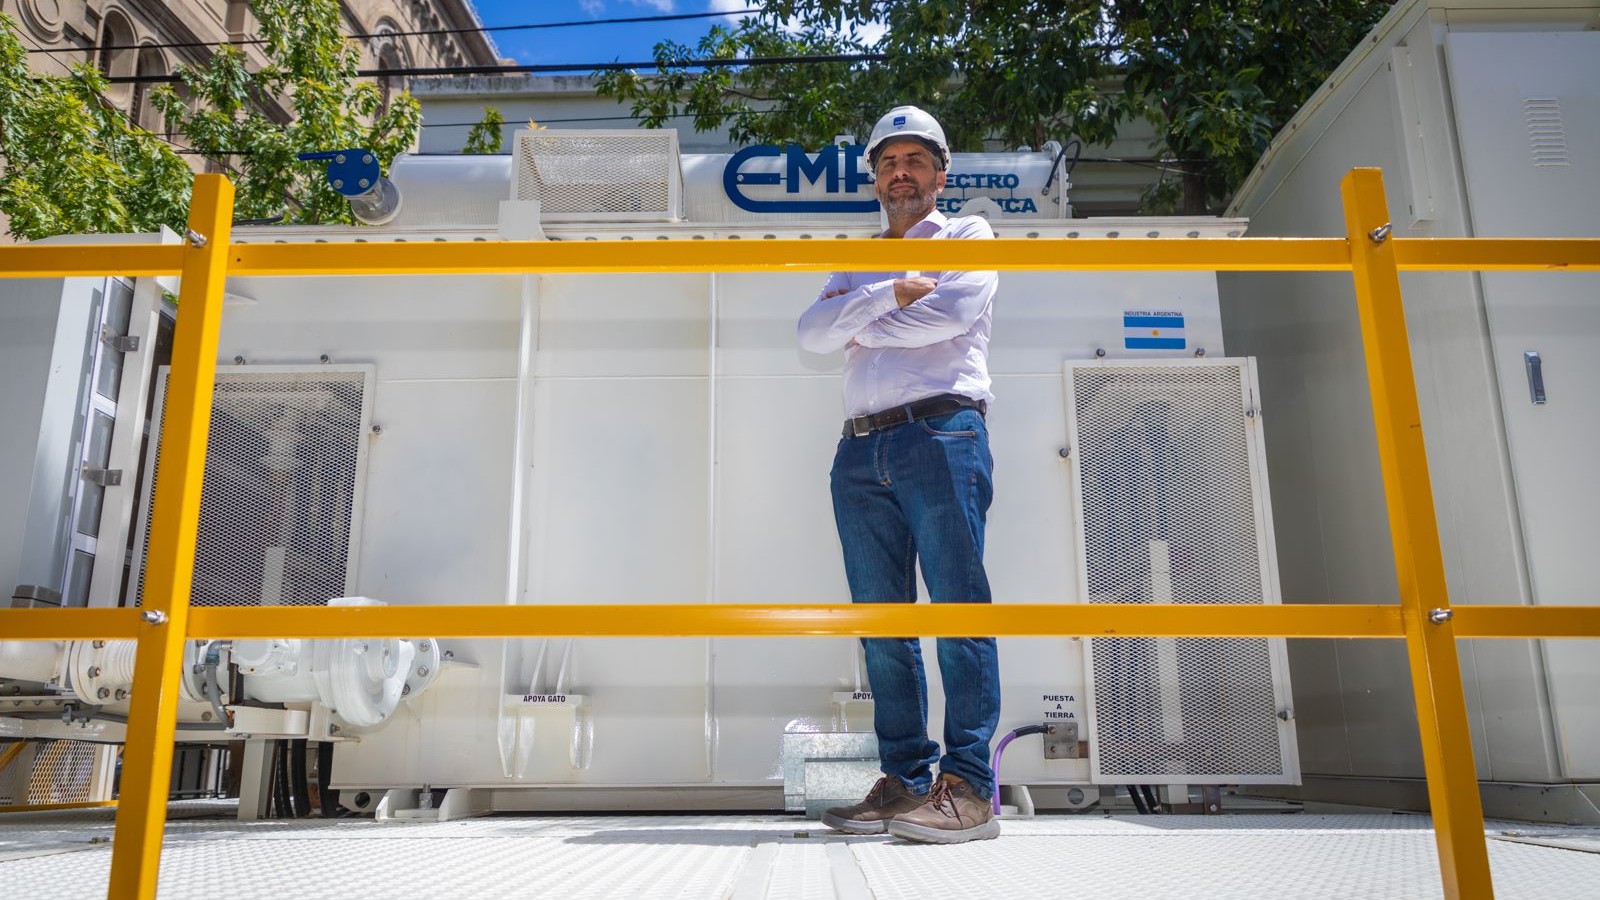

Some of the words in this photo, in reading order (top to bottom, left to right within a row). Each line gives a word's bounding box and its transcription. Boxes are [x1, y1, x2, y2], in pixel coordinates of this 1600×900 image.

[944, 173, 1019, 188] ECTRO
[547, 695, 566, 703] GATO
[852, 692, 873, 700] APOY
[1044, 711, 1074, 719] TIERRA
